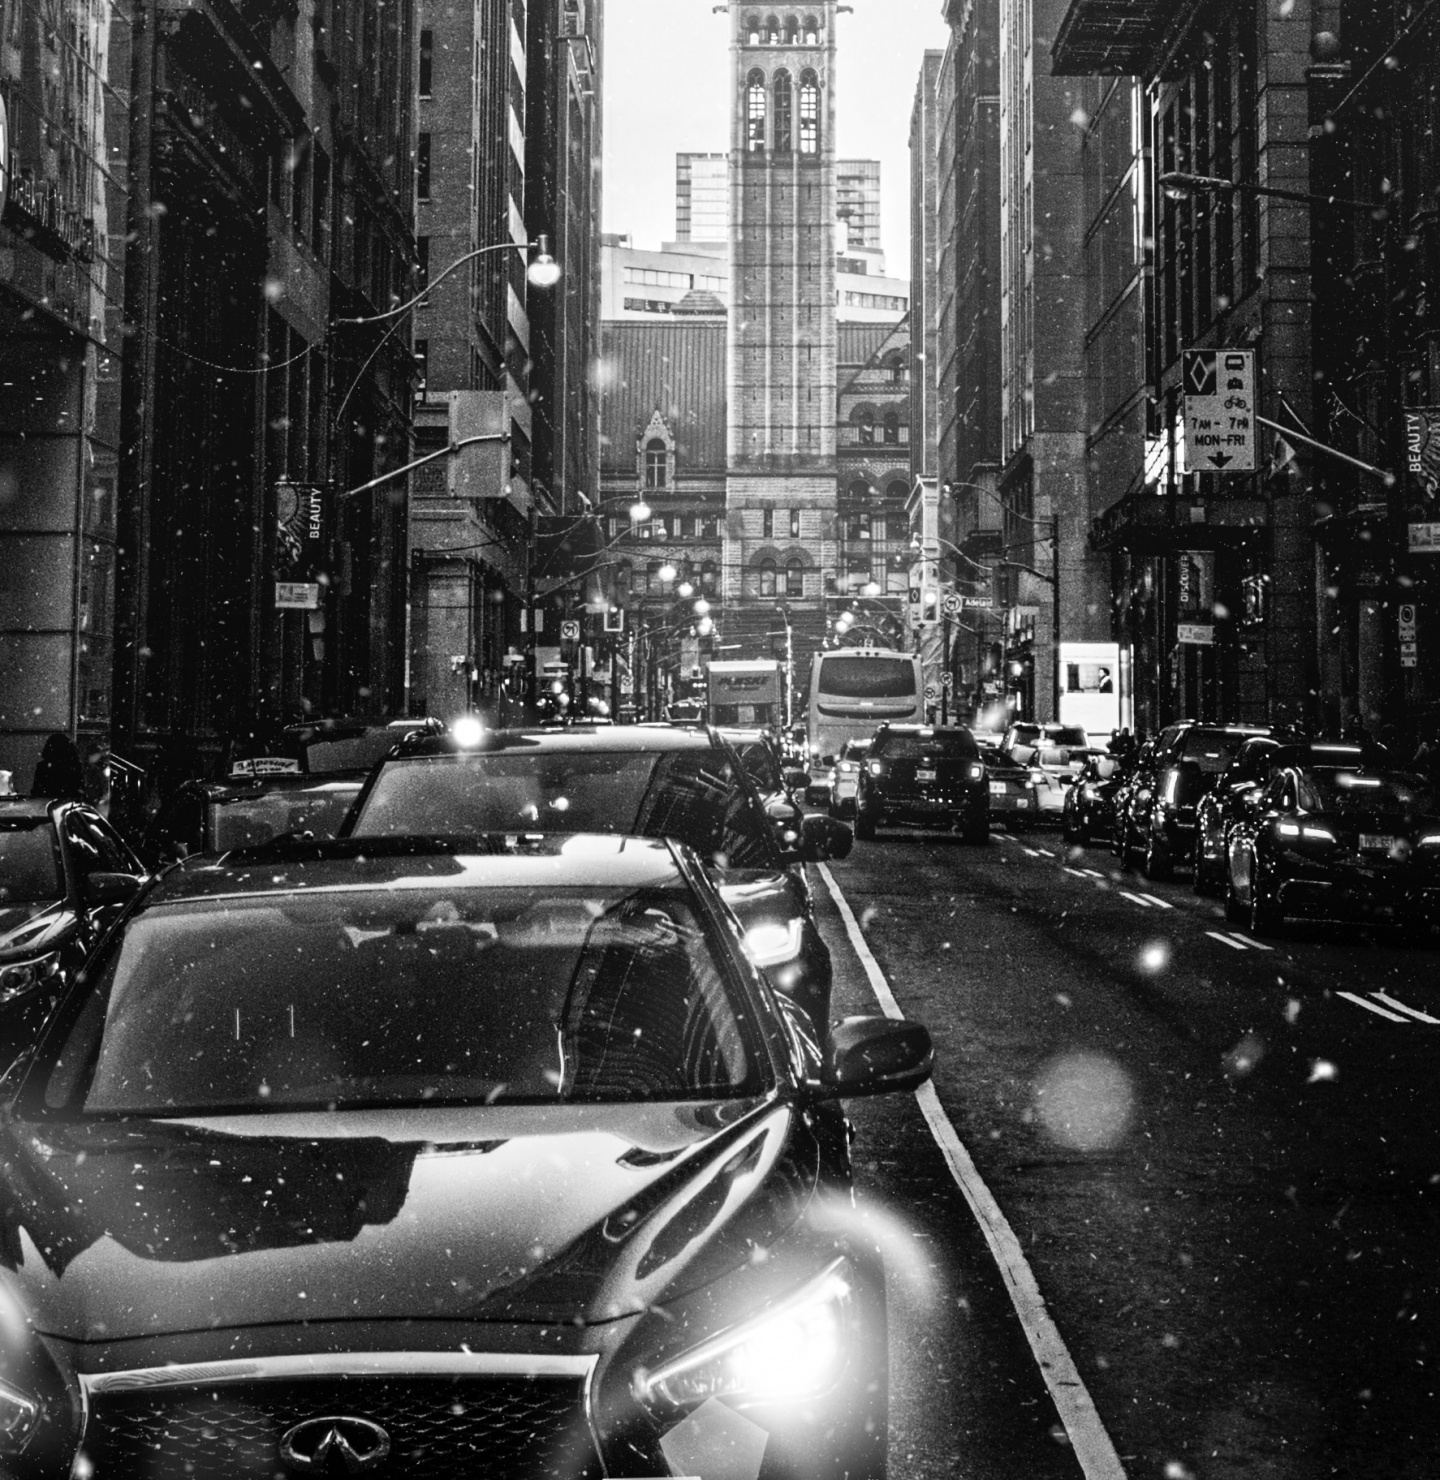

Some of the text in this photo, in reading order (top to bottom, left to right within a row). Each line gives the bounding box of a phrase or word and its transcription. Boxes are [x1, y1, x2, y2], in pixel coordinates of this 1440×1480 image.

[1194, 434, 1246, 446] MON-FRI
[1407, 414, 1421, 471] BEAUTY
[310, 488, 322, 539] BEAUTY
[1180, 555, 1190, 602] DISCOVER
